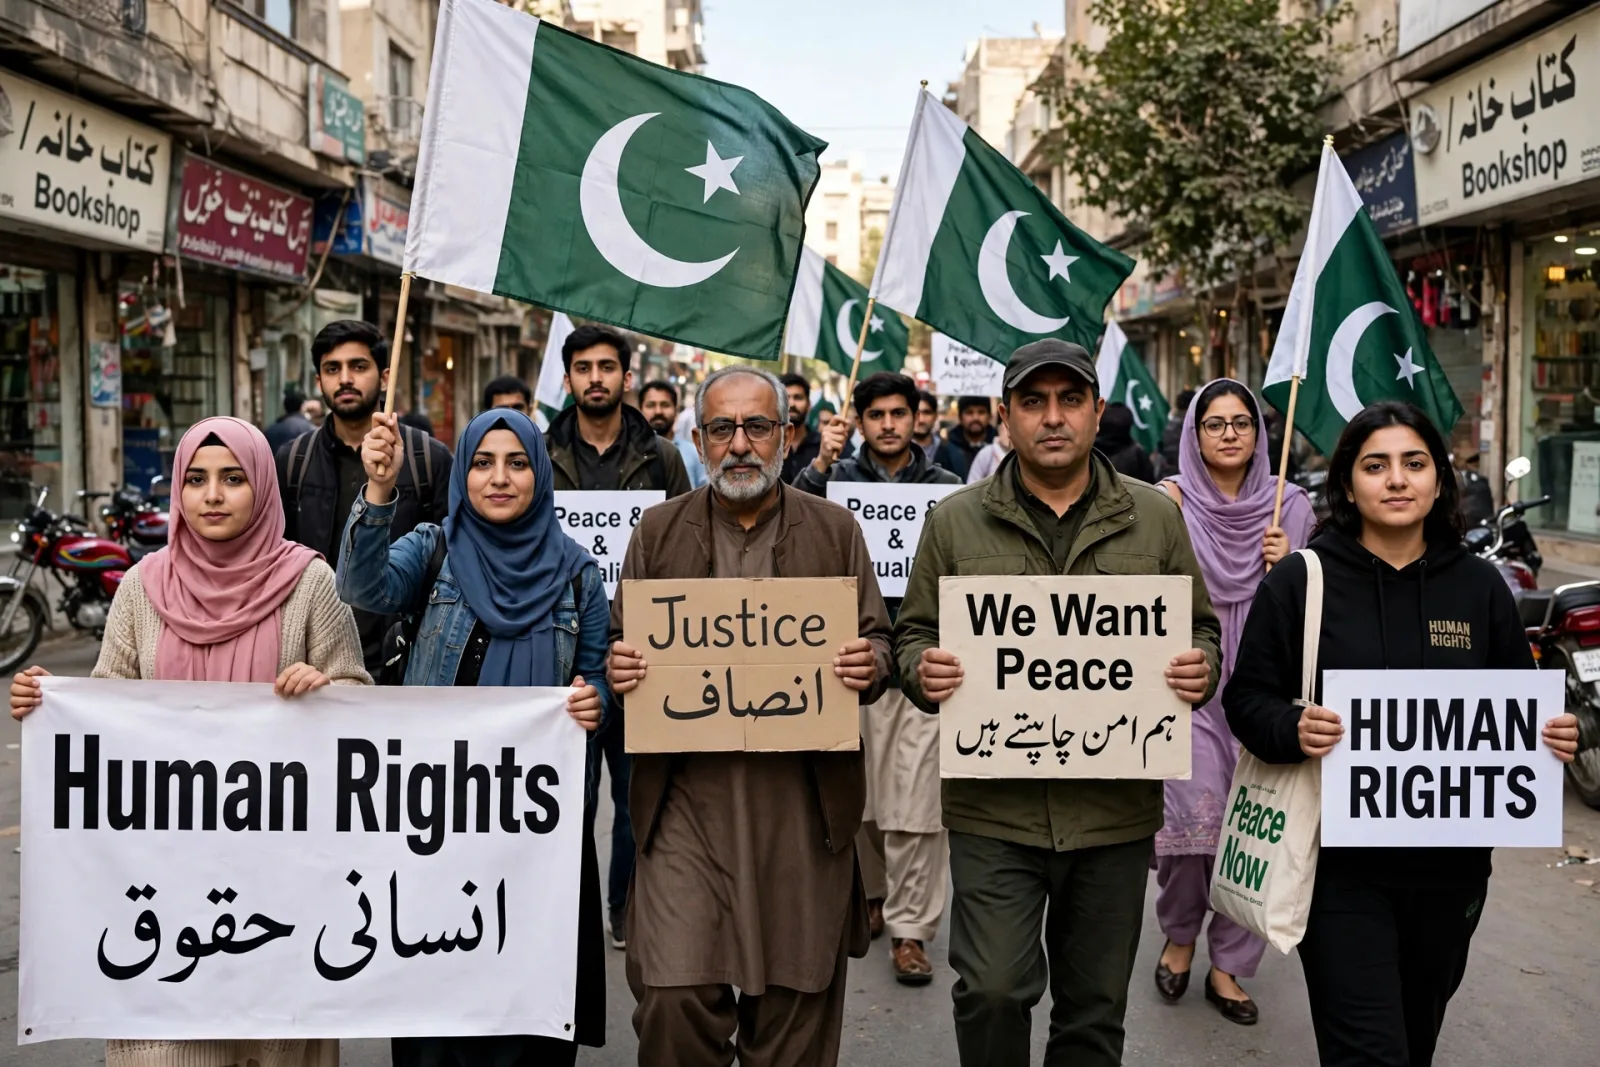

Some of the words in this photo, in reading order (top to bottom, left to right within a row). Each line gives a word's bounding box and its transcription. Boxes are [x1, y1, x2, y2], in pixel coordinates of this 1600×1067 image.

[1459, 77, 1504, 144] خانہ
[1511, 34, 1577, 135] کتاب
[36, 110, 94, 163] خانہ
[100, 135, 159, 187] کتاب
[1462, 138, 1568, 198] Bookshop
[34, 171, 140, 239] Bookshop
[554, 506, 621, 528] Peace
[848, 498, 916, 521] Peace
[592, 534, 609, 556] &
[887, 528, 904, 550] &
[648, 595, 827, 650] Justice
[966, 594, 1036, 636] We
[1050, 594, 1168, 637] Want
[1429, 620, 1471, 636] HUMAN
[1430, 633, 1472, 650] RIGHTS
[663, 666, 823, 723] انصاف
[997, 648, 1134, 691] Peace
[956, 718, 1000, 757] ہیں
[1082, 714, 1138, 757] امن
[1143, 714, 1177, 769] ہم
[1350, 698, 1538, 752] HUMAN
[54, 733, 308, 832] Human
[335, 737, 560, 856] Rights
[1228, 785, 1286, 844] Peace
[1350, 765, 1537, 819] RIGHTS
[1219, 834, 1269, 892] Now
[97, 883, 296, 983] حقوق
[313, 869, 507, 982] انسانی
